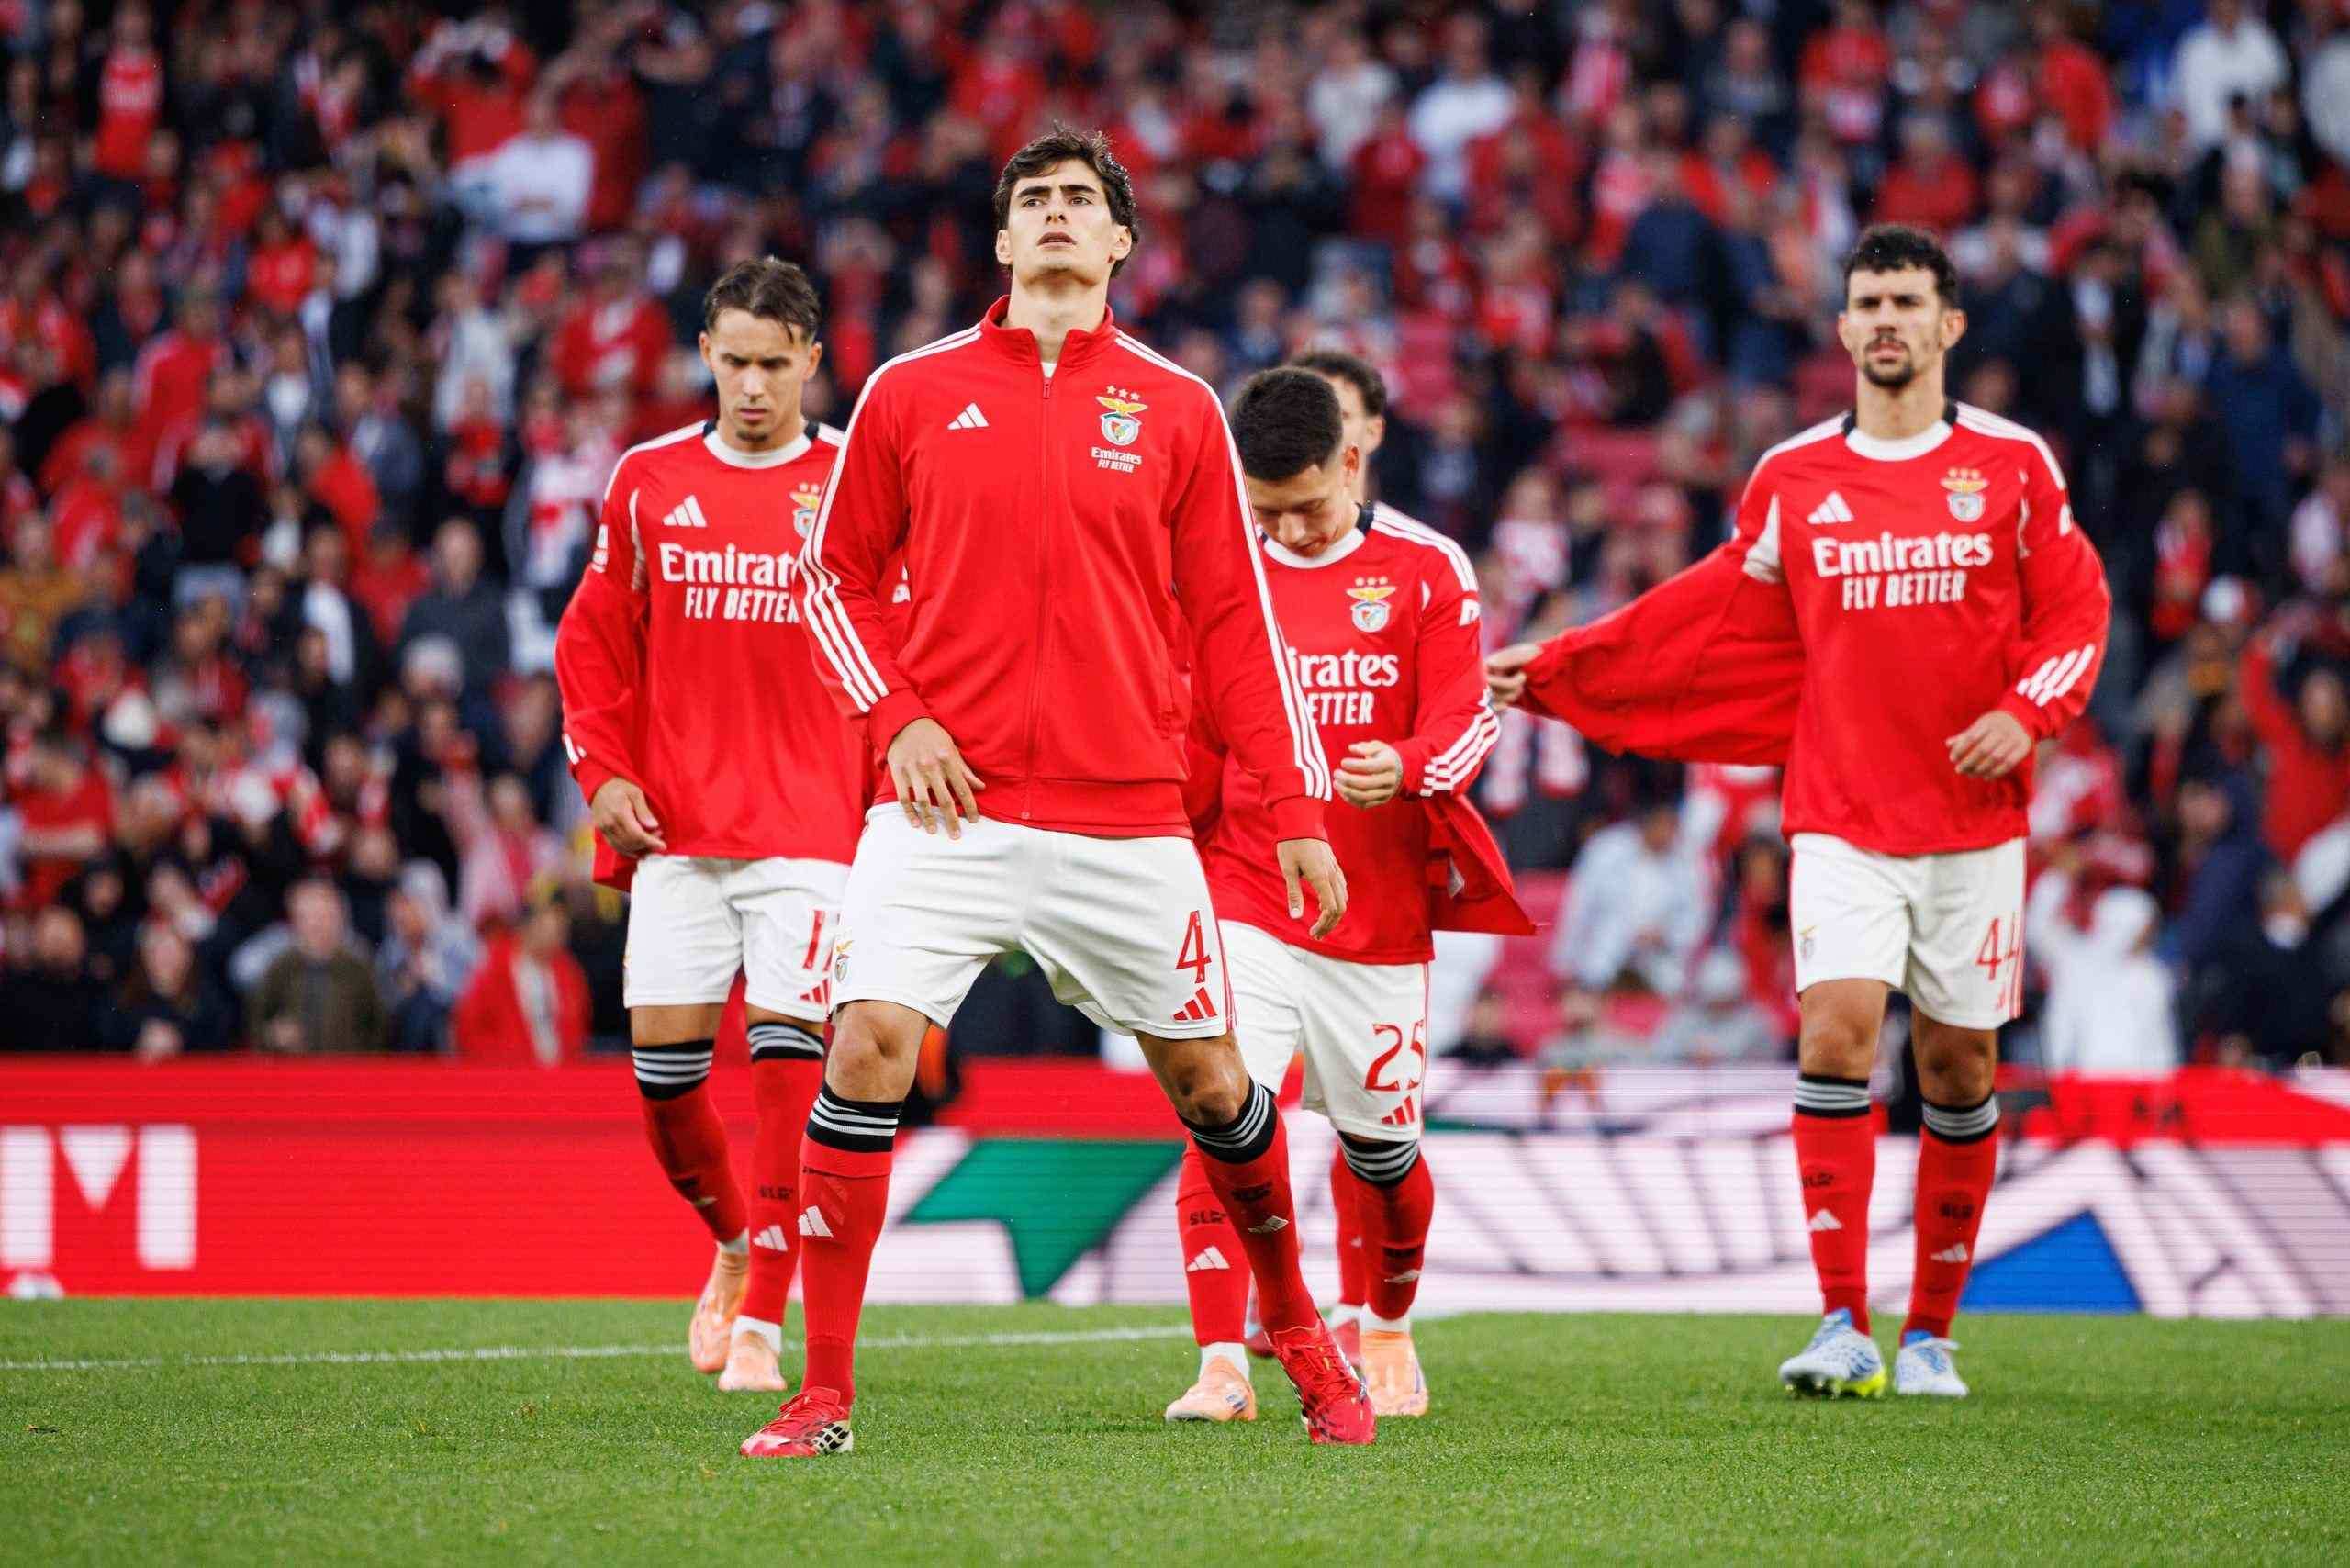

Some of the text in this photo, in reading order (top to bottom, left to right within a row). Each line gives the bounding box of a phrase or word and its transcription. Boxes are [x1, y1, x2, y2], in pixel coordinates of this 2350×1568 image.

[658, 543, 799, 588] Emirat
[1812, 531, 1994, 577] Emirates
[685, 586, 720, 619] FLY
[1842, 570, 1967, 610] FLY BETTER
[1288, 646, 1399, 687] irates
[1307, 691, 1374, 725] ETTER
[1175, 910, 1212, 984] 4
[1365, 1019, 1424, 1091] 25
